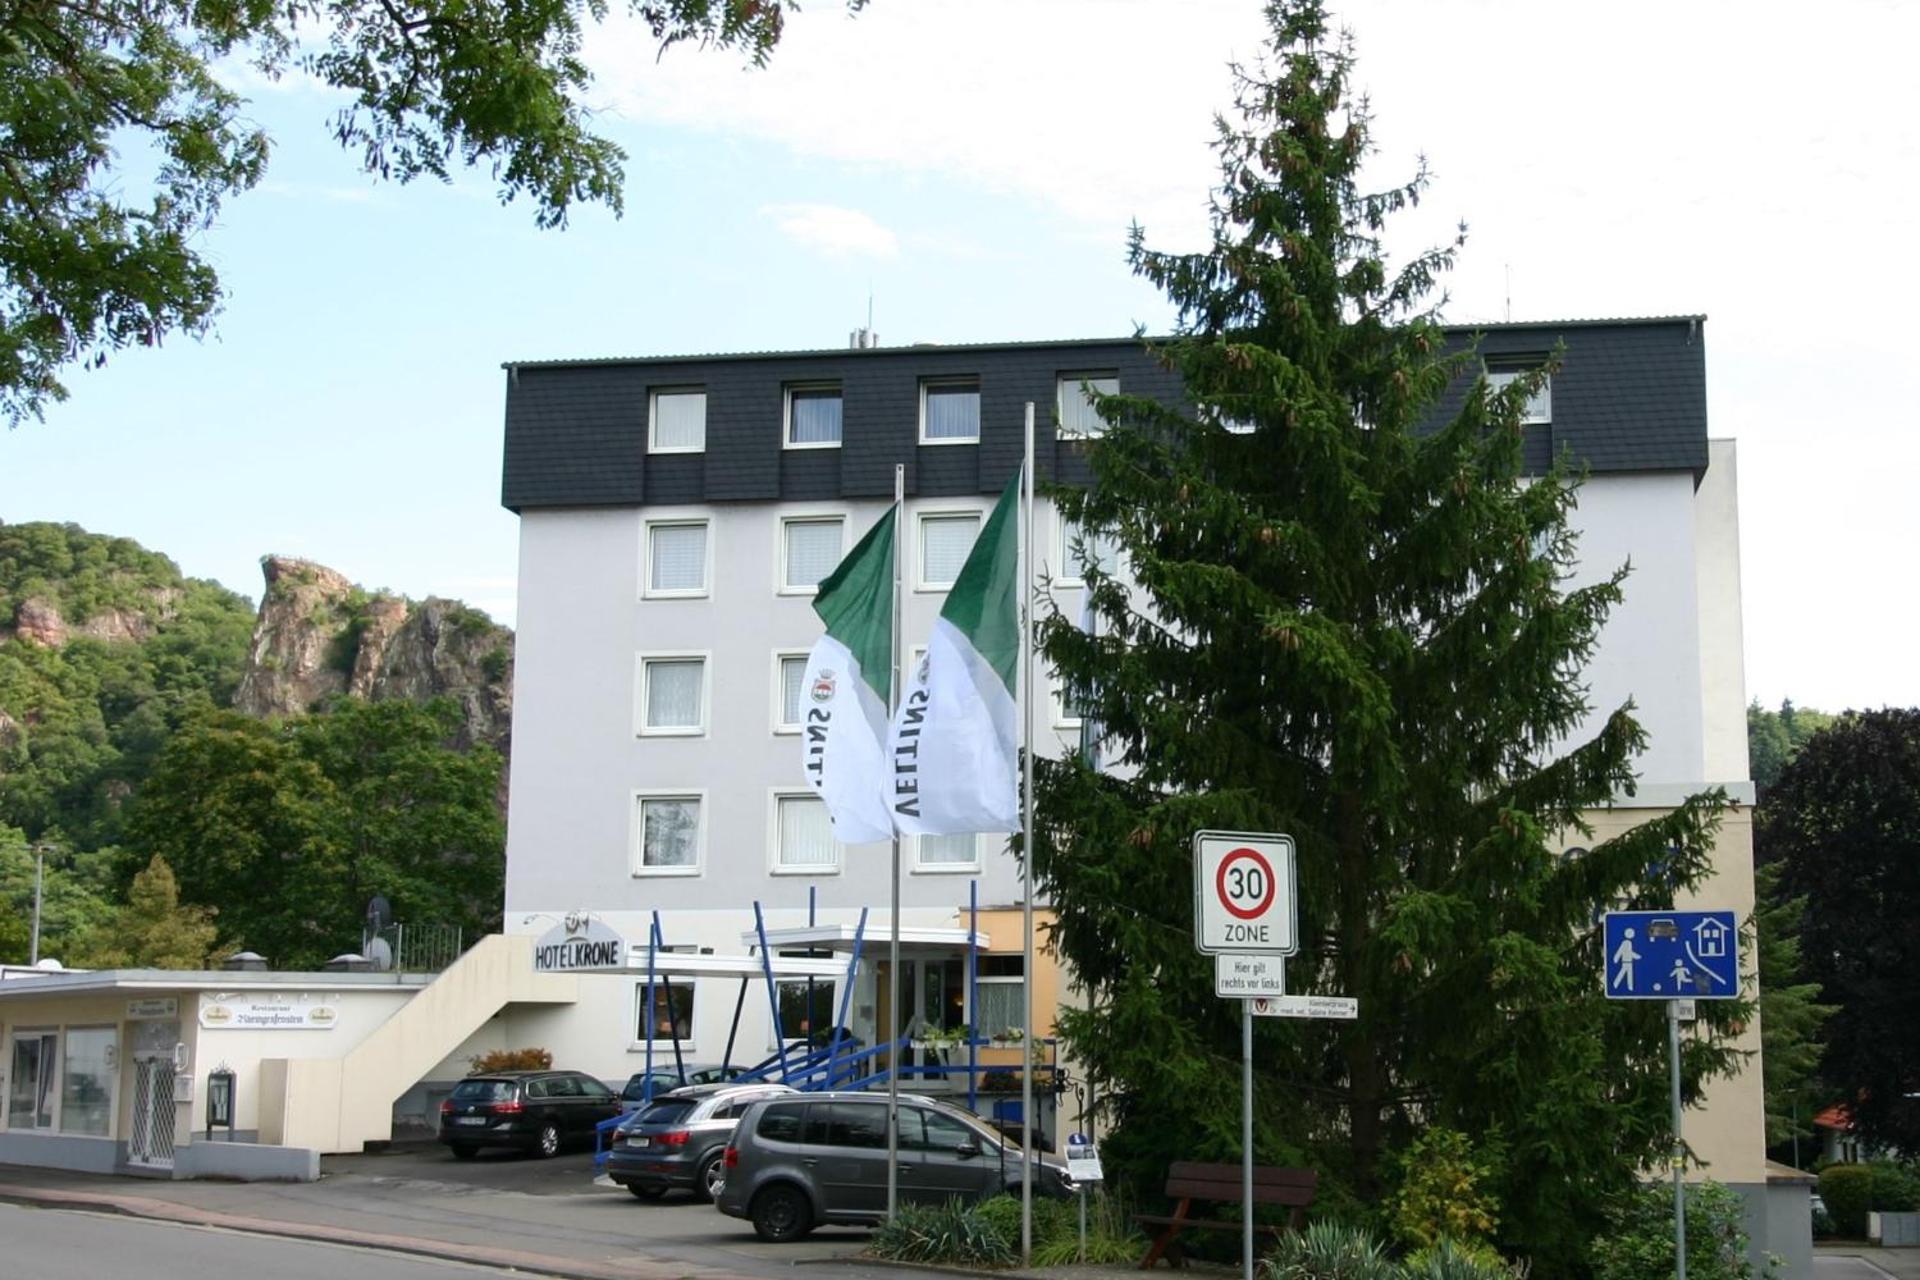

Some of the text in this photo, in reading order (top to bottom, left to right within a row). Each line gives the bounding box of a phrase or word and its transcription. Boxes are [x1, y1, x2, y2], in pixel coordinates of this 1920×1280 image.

[1229, 868, 1262, 899] 30
[1224, 924, 1269, 942] ZONE
[535, 941, 619, 969] HOTEL KRONE
[1234, 962, 1266, 976] Hier gilt
[1221, 978, 1280, 989] rechts vor links
